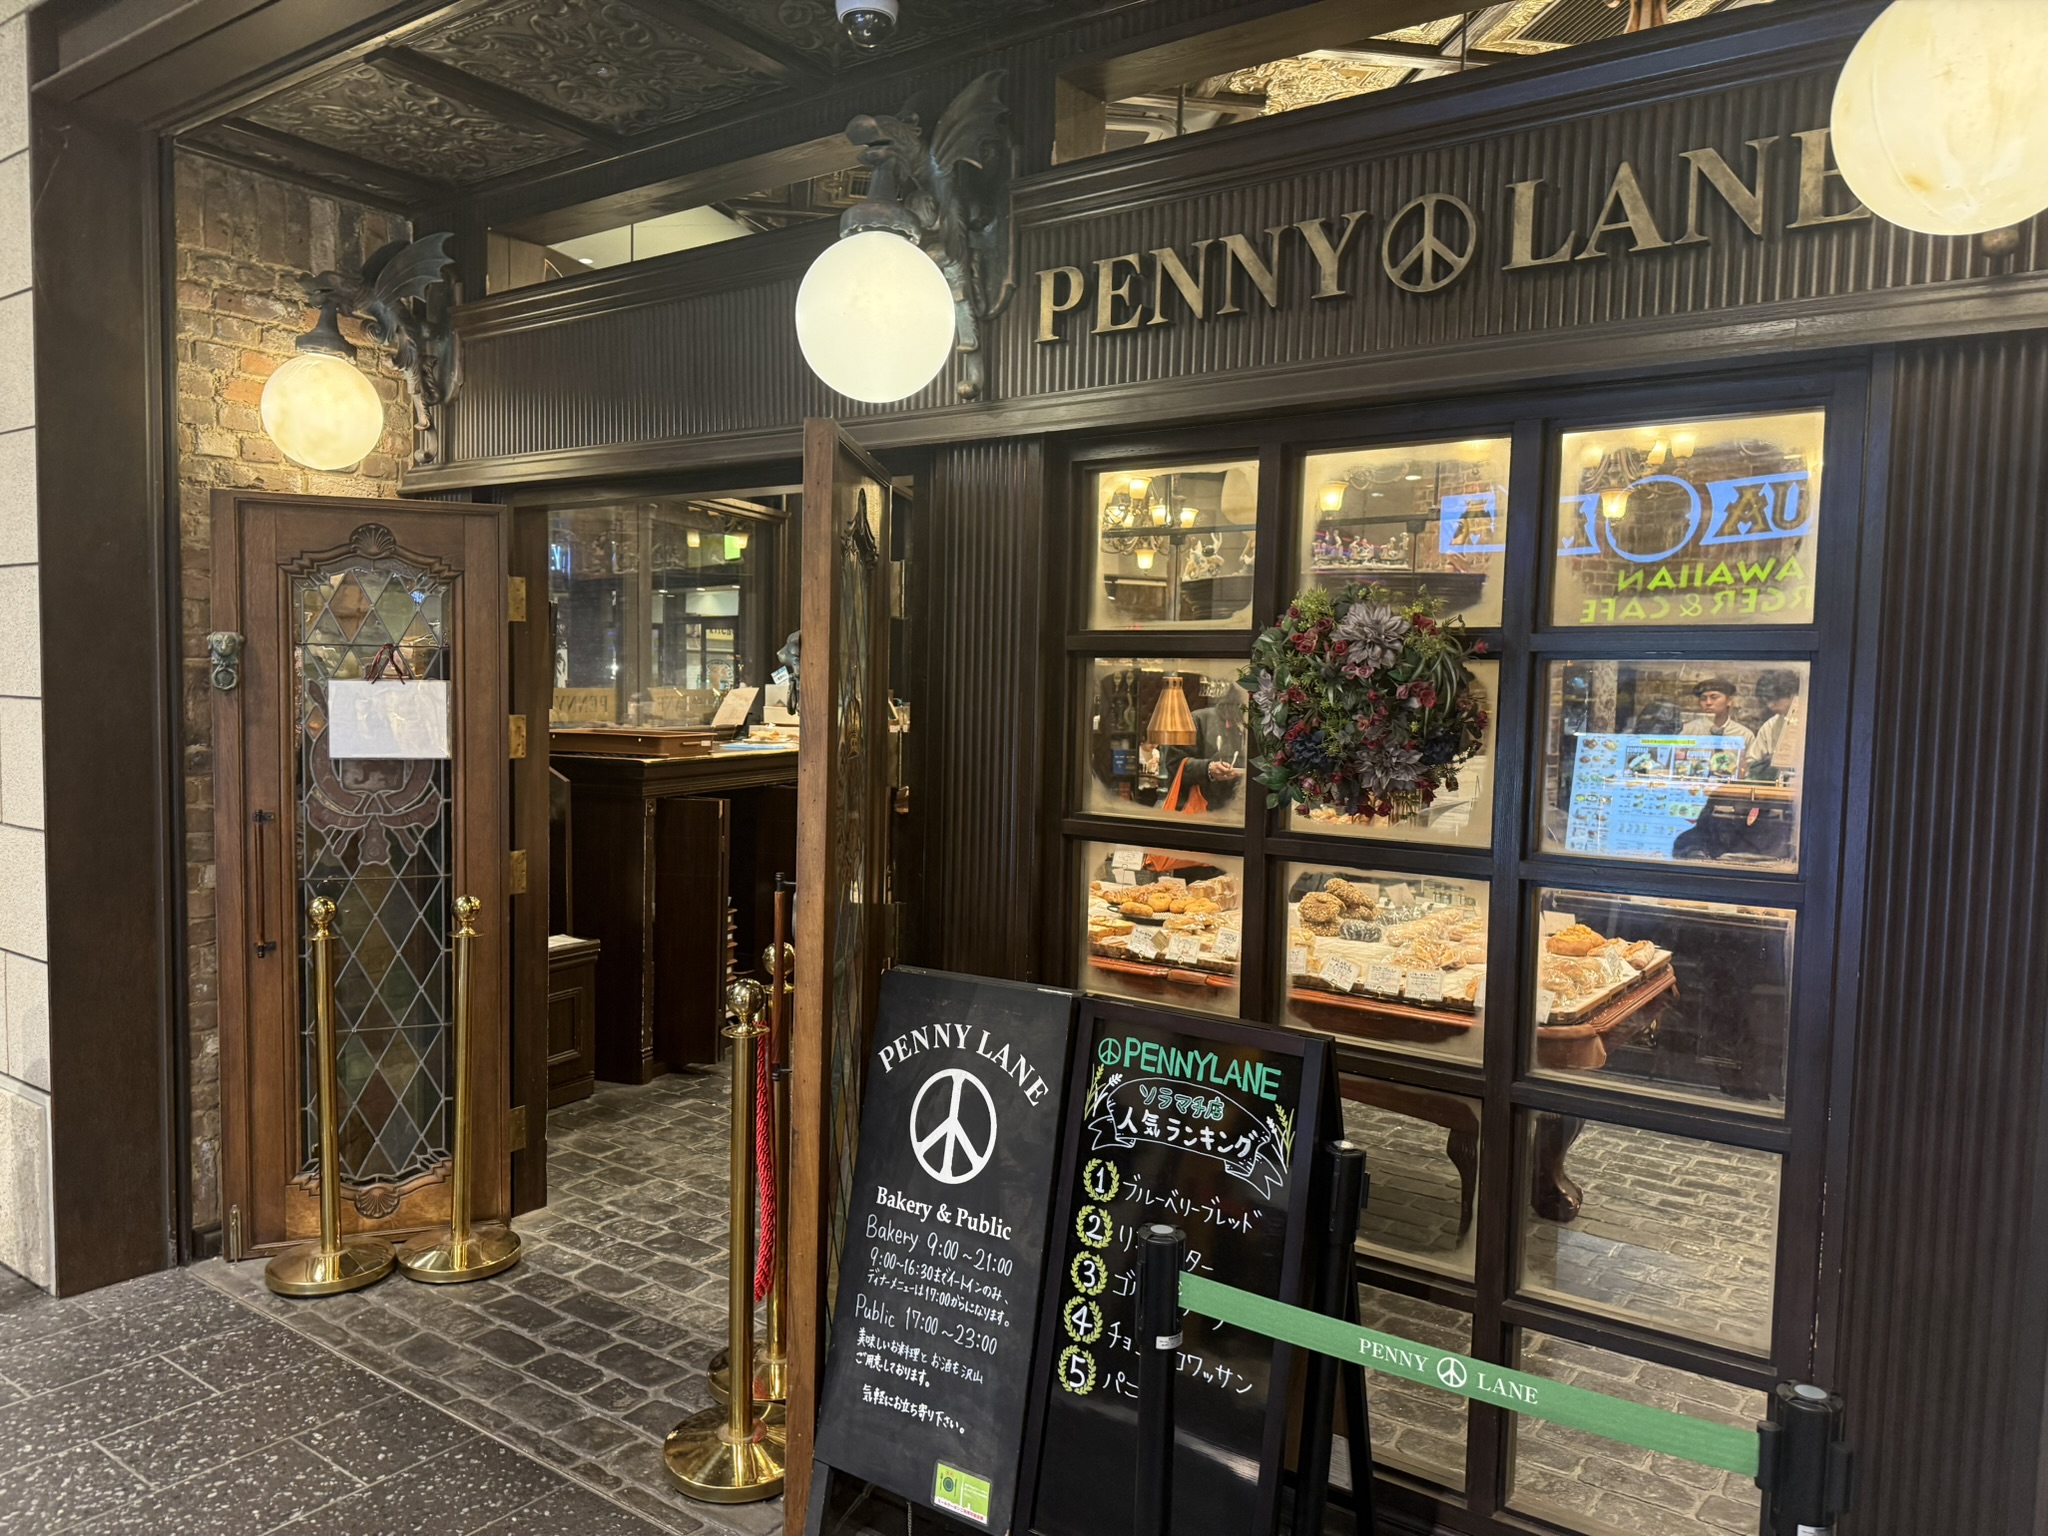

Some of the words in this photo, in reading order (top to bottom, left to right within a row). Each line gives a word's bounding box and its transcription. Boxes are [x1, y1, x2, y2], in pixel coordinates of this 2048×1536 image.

[1034, 210, 1370, 344] PENNY
[877, 1022, 972, 1074] PENNY
[976, 1029, 1049, 1107] LANE
[1123, 1036, 1282, 1101] PENNYLANE
[1139, 1084, 1225, 1120] ソラマチ店
[1117, 1107, 1259, 1157] 人気ランキング
[876, 1186, 932, 1222] Bakery
[936, 1203, 952, 1224] &
[955, 1207, 1012, 1240] Public
[1094, 1166, 1105, 1193] 1
[1123, 1173, 1262, 1233] ブルーベリーブレッド
[866, 1213, 919, 1252] Bakery
[1086, 1214, 1104, 1240] 2
[1083, 1259, 1096, 1288] 3
[855, 1293, 895, 1328] Public
[1071, 1305, 1093, 1336] 4
[855, 1352, 930, 1388] ご用意しております。
[1069, 1355, 1086, 1388] 5
[1359, 1338, 1429, 1372] PENNY
[1477, 1372, 1539, 1405] LANE
[862, 1383, 965, 1434] 気軽にお立ち寄り下さい。
